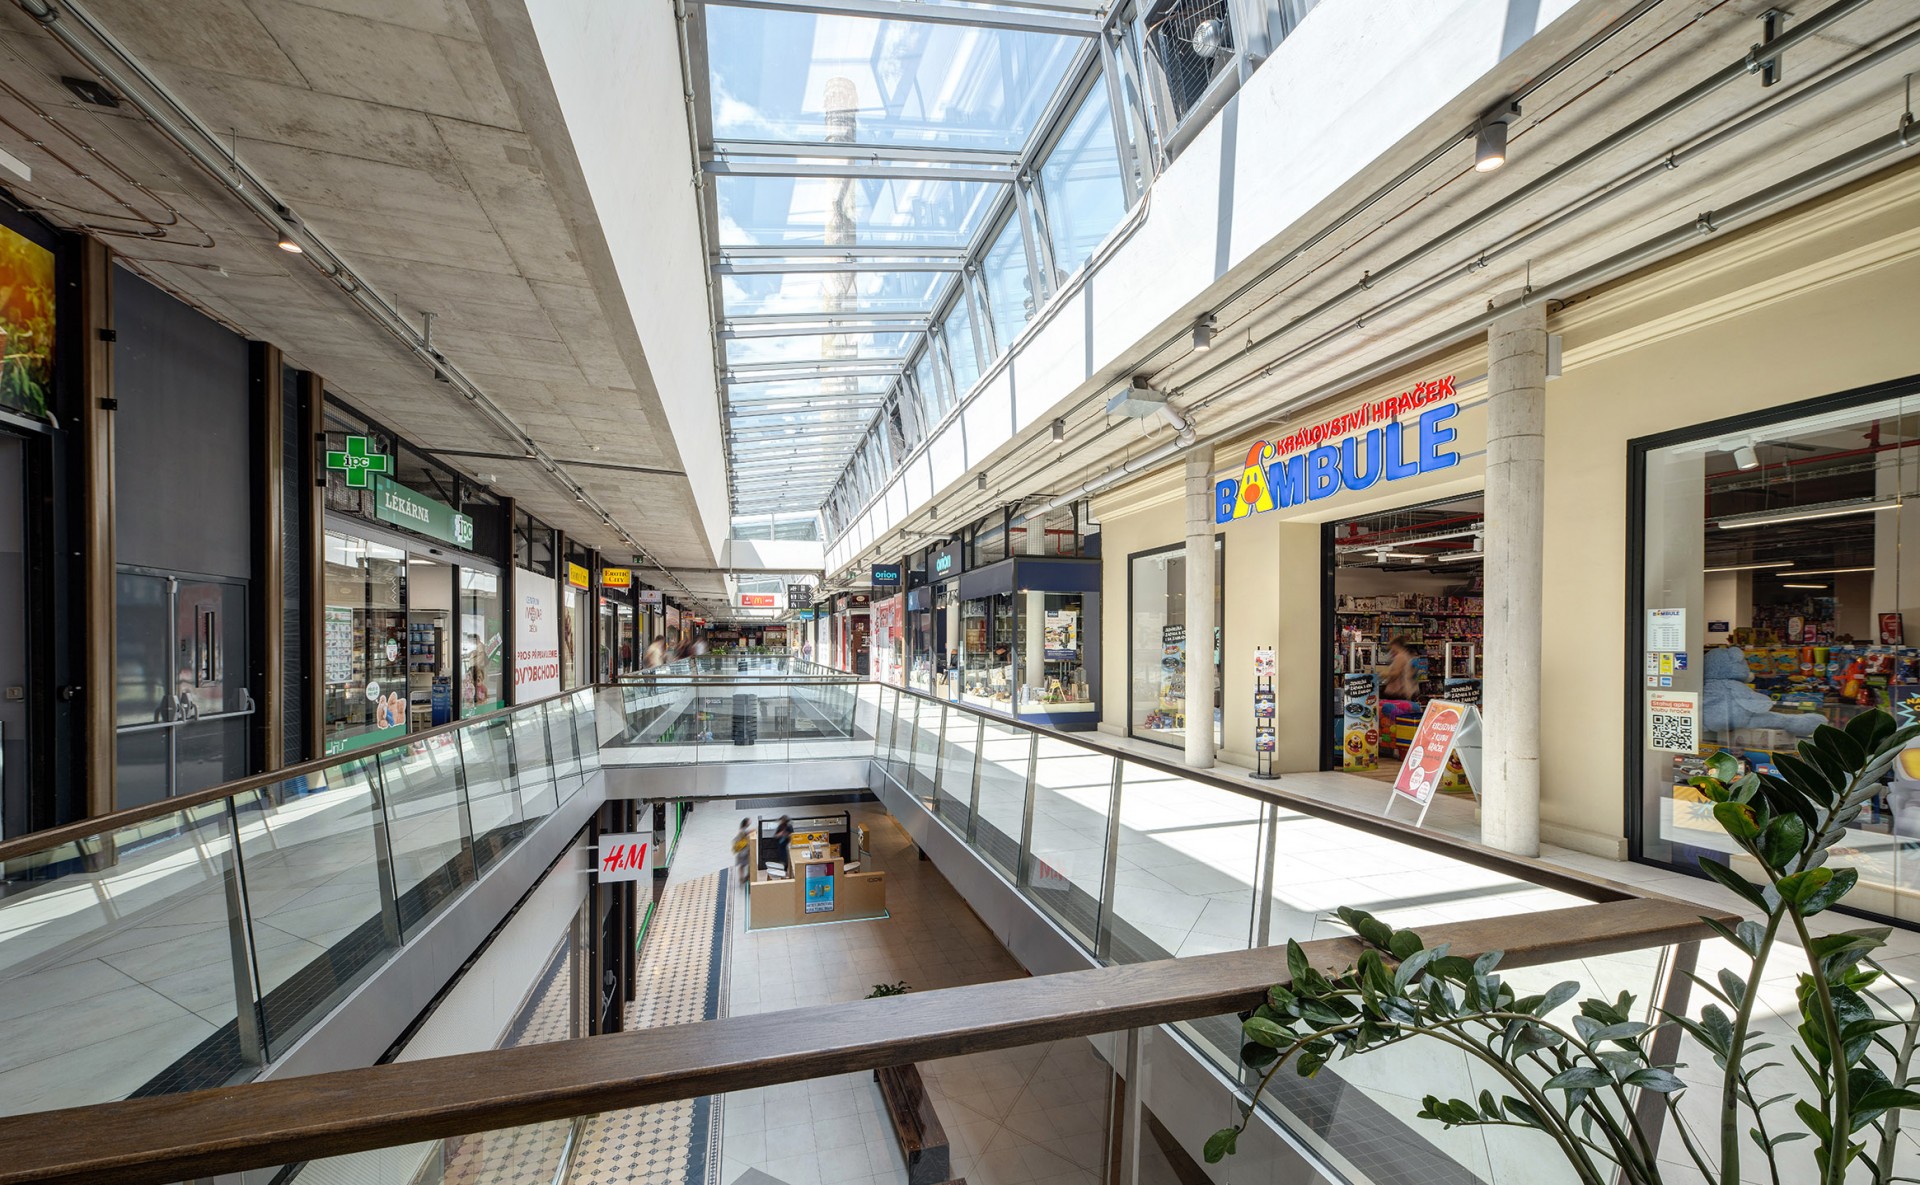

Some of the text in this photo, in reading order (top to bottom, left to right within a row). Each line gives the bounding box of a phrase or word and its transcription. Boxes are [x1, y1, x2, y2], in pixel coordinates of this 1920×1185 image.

[1277, 375, 1456, 456] KRÁLOVSTVÍ HRAČEK
[344, 455, 369, 468] ipc
[1215, 403, 1460, 525] BAMBULE
[385, 491, 430, 523] LÉKÁRNA
[875, 570, 897, 579] orion
[603, 843, 647, 872] H&M
